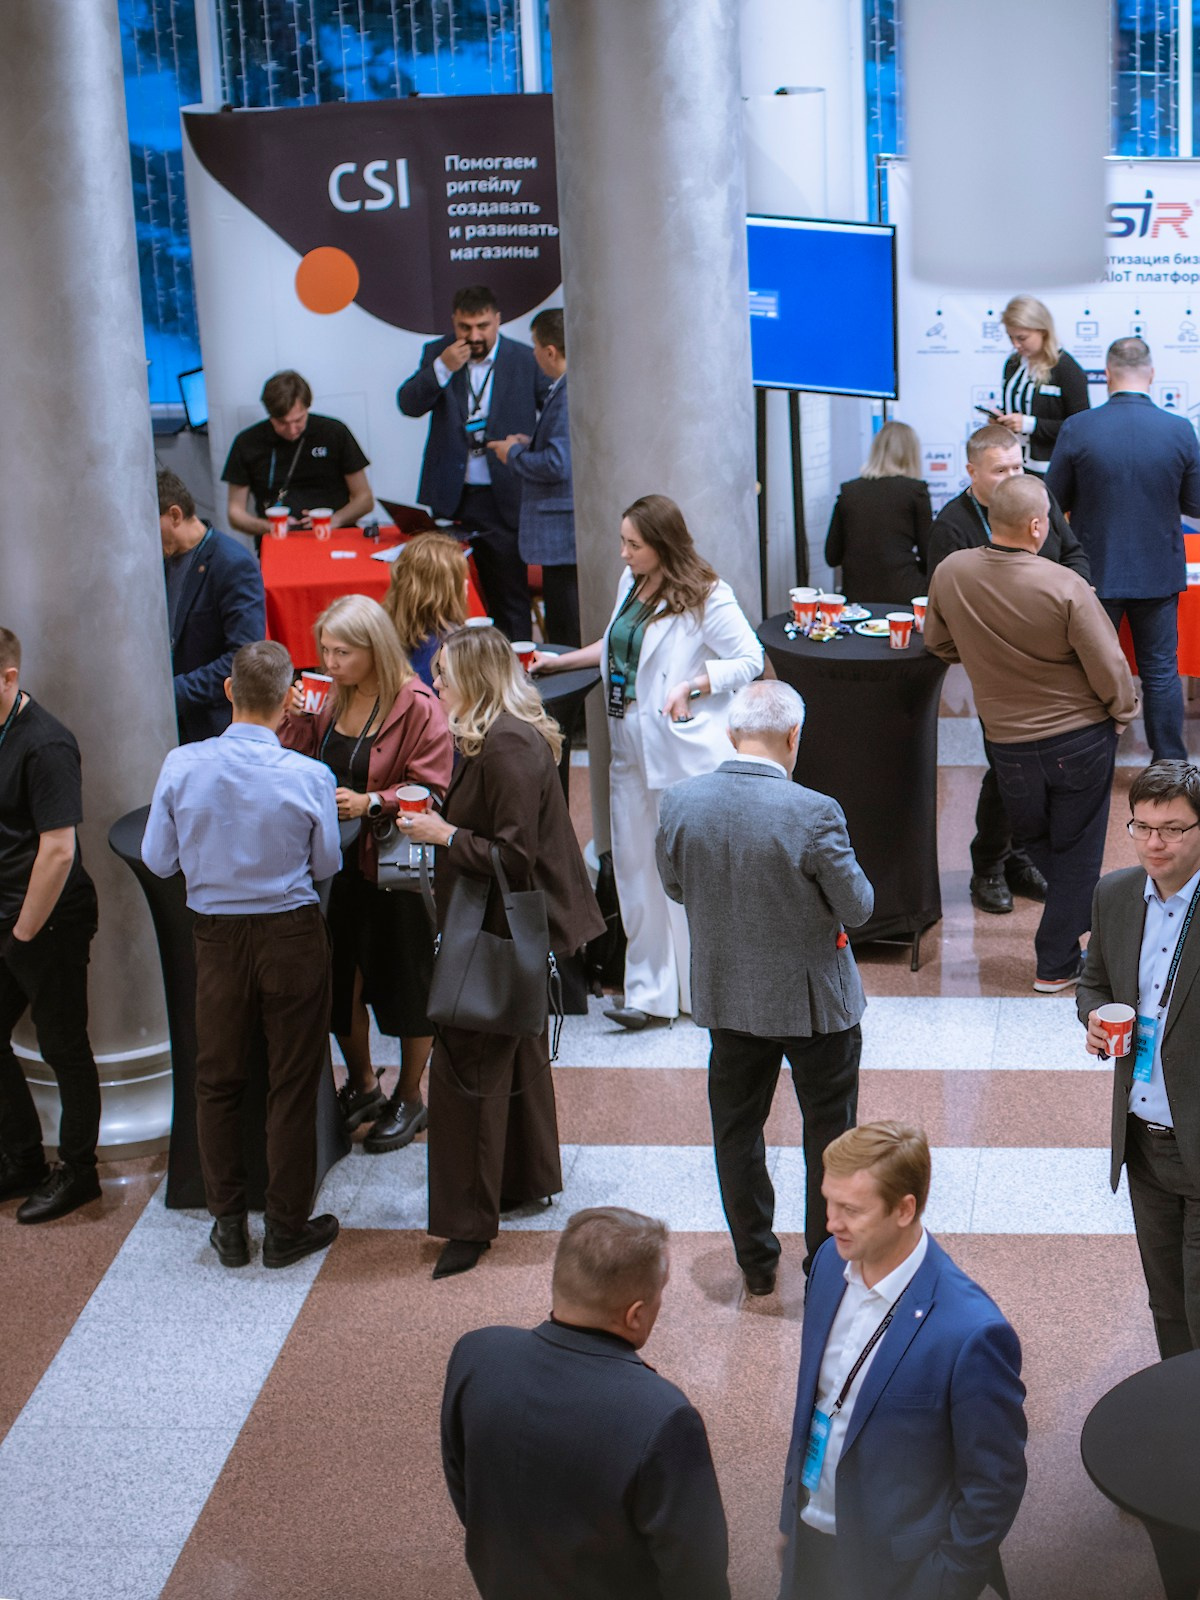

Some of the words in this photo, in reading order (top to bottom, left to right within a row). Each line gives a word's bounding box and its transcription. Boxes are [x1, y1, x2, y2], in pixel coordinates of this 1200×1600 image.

[444, 155, 538, 172] Помогаем
[328, 158, 410, 213] CSI
[447, 176, 522, 197] ритейлу
[447, 201, 541, 217] создавать
[449, 226, 461, 239] и
[465, 223, 559, 241] развивать
[450, 246, 539, 261] магазины
